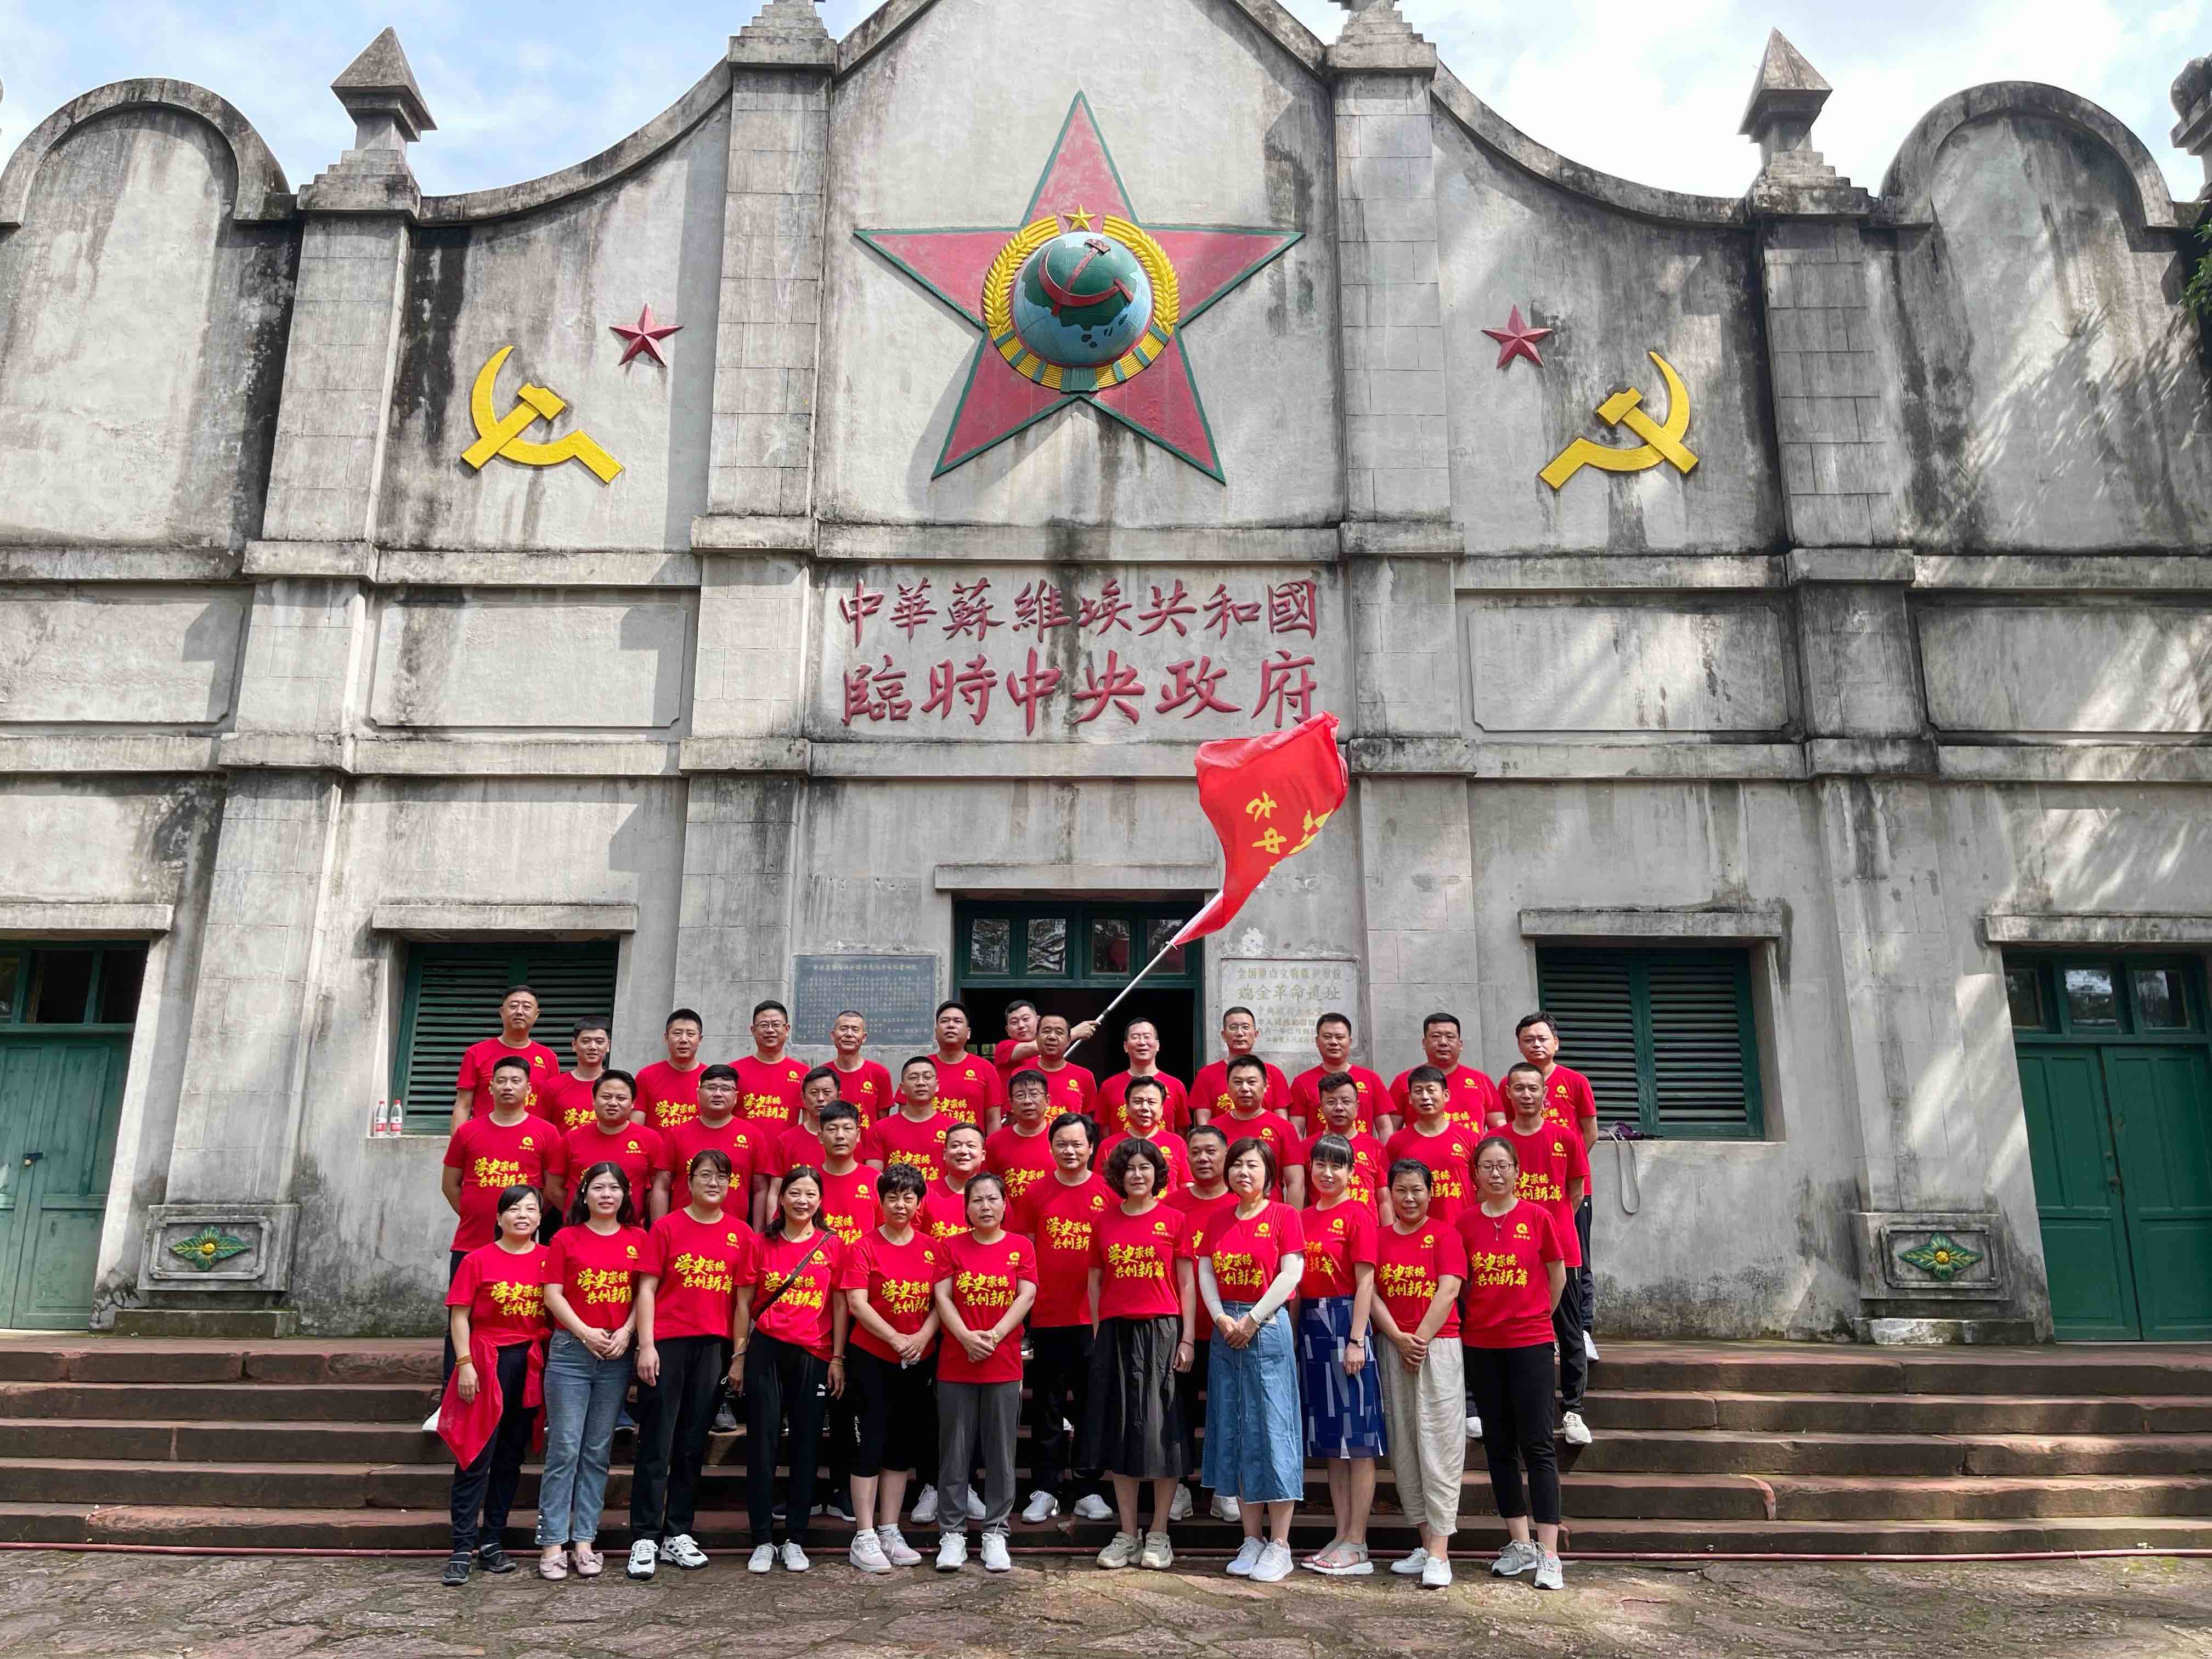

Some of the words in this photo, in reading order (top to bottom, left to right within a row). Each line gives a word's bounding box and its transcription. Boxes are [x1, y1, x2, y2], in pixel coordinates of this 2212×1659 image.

[840, 577, 1318, 648] 中華蘇維埃共和國
[840, 646, 1319, 737] 臨時中央政府
[564, 1108, 597, 1125] 学史崇
[474, 1156, 520, 1177] 学史崇德
[1431, 1170, 1450, 1181] 崇德
[1430, 1182, 1461, 1198] 新篇
[1515, 1171, 1549, 1190] 史崇德
[1008, 1186, 1025, 1198] 共创
[825, 1213, 855, 1234] 史崇德
[1046, 1216, 1092, 1238] 学史崇德
[837, 1228, 862, 1244] 新篇
[1053, 1234, 1089, 1249] 共创新
[1109, 1243, 1156, 1266] 学史崇德
[1307, 1242, 1321, 1252] 崇德
[674, 1252, 727, 1276] 学史崇德
[1114, 1260, 1165, 1278] 共创新篇
[1307, 1256, 1334, 1276] 新篇
[1474, 1252, 1518, 1272] 学史崇德
[577, 1267, 629, 1291] 学史崇德
[682, 1273, 732, 1294] 共创新篇
[956, 1271, 1010, 1294] 学史崇德
[1219, 1267, 1263, 1287] 创新篇
[1381, 1263, 1427, 1285] 学史崇德
[1476, 1267, 1528, 1286] 共创新篇
[772, 1289, 823, 1309] 创新篇
[882, 1279, 930, 1302] 学史崇德
